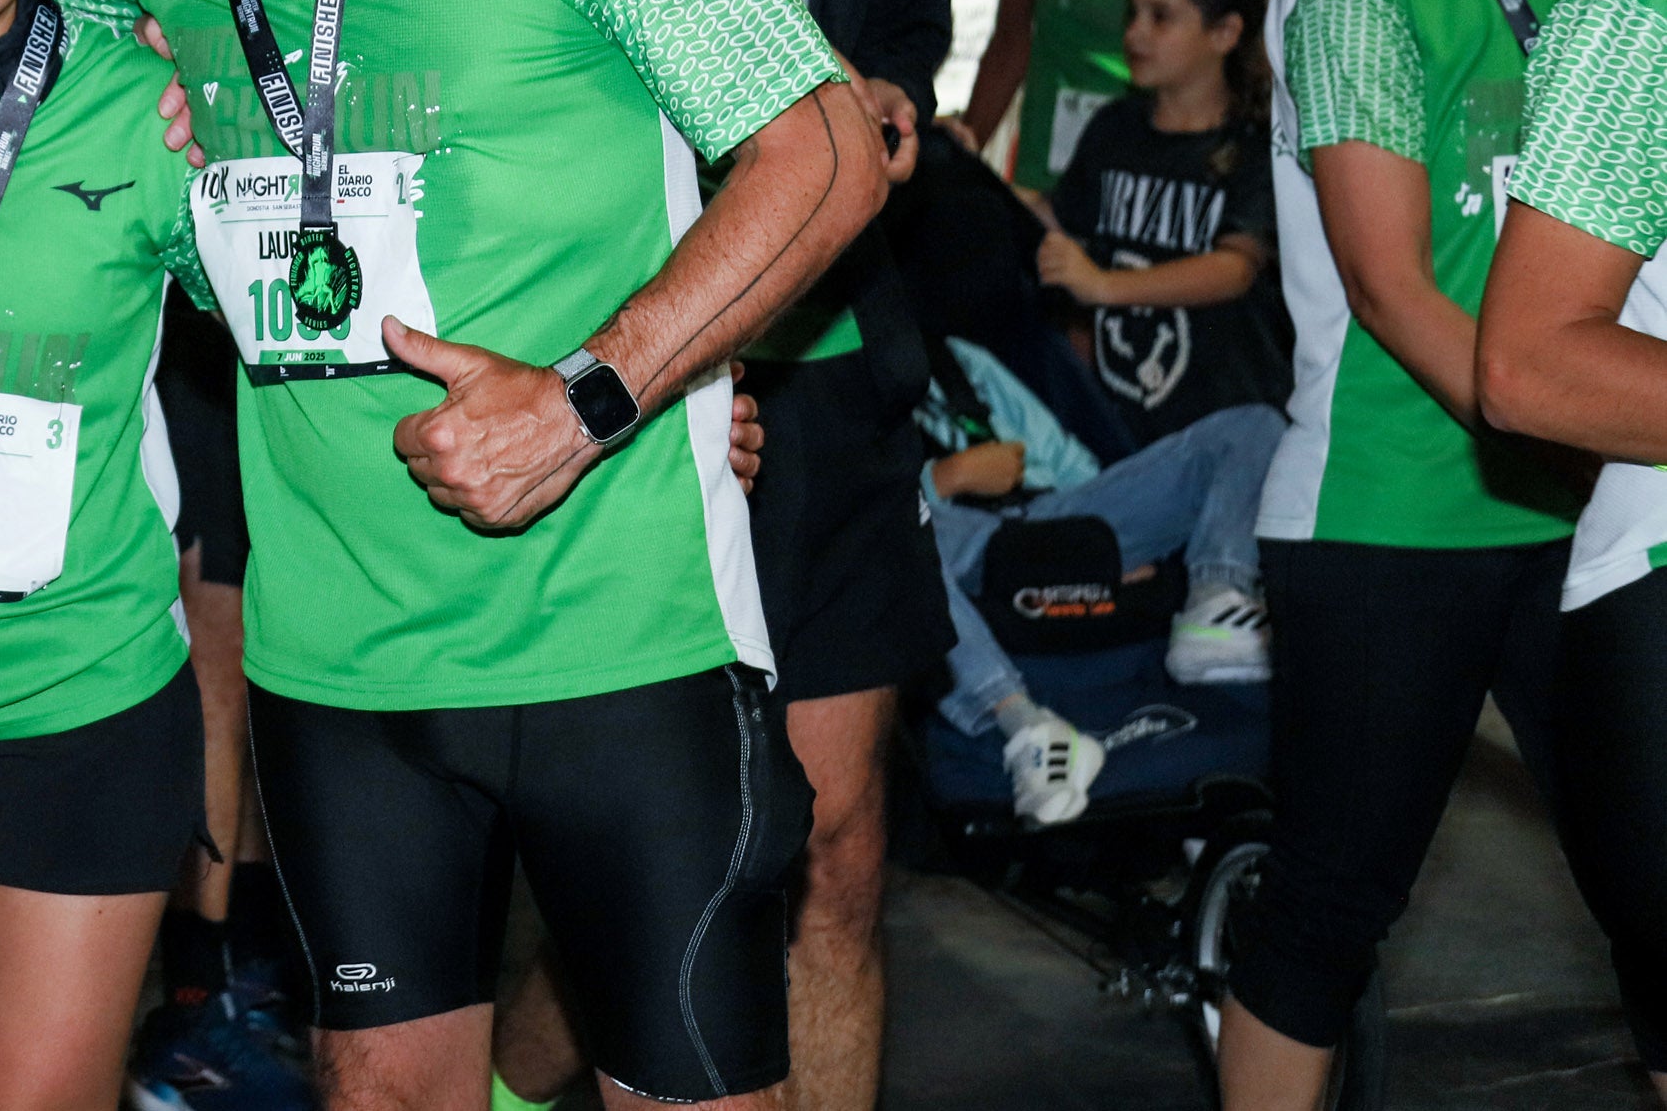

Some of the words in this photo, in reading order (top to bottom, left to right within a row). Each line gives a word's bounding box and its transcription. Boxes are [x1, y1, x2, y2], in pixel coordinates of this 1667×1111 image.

[13, 4, 60, 96] FINISHER
[338, 164, 350, 175] EL
[337, 174, 373, 187] DIARIO
[337, 186, 372, 198] VASCO
[277, 353, 283, 362] 7
[284, 352, 303, 362] JUN
[304, 352, 326, 362] 2025
[46, 418, 64, 450] 3
[330, 976, 396, 992] Kalenji
